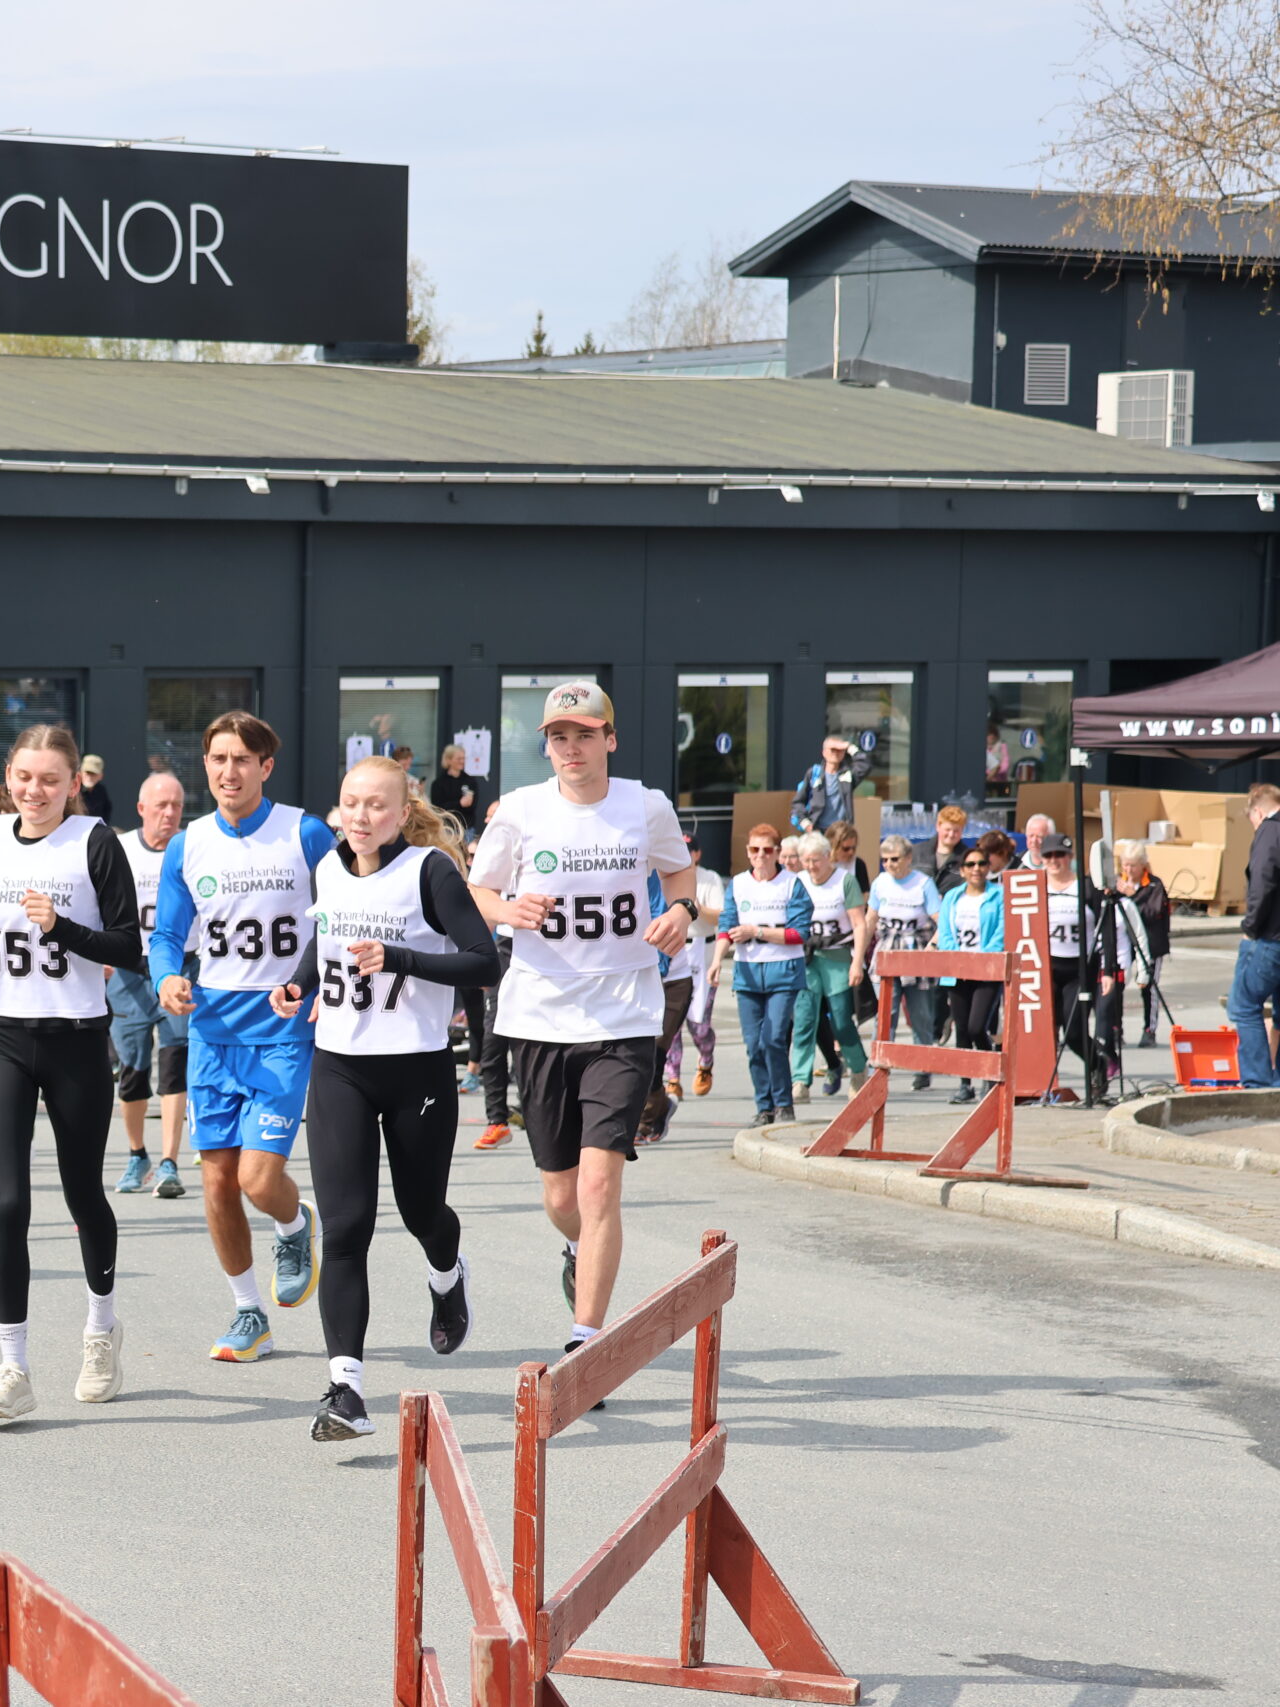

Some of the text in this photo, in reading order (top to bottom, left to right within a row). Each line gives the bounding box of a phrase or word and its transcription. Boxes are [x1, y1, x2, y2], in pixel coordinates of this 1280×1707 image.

[562, 844, 638, 859] Sparebanken
[221, 865, 295, 882] Sparebanken
[562, 858, 637, 872] HEDMARK
[2, 876, 73, 892] Sparebanken
[221, 879, 295, 895] HEDMARK
[0, 890, 72, 907] HEDRK
[332, 909, 407, 925] Sparebanken
[539, 891, 638, 942] 558
[207, 914, 299, 961] 536
[331, 924, 407, 942] HEDMARK
[1009, 874, 1042, 1033] START
[322, 959, 408, 1013] 537
[258, 1113, 295, 1129] DSV
